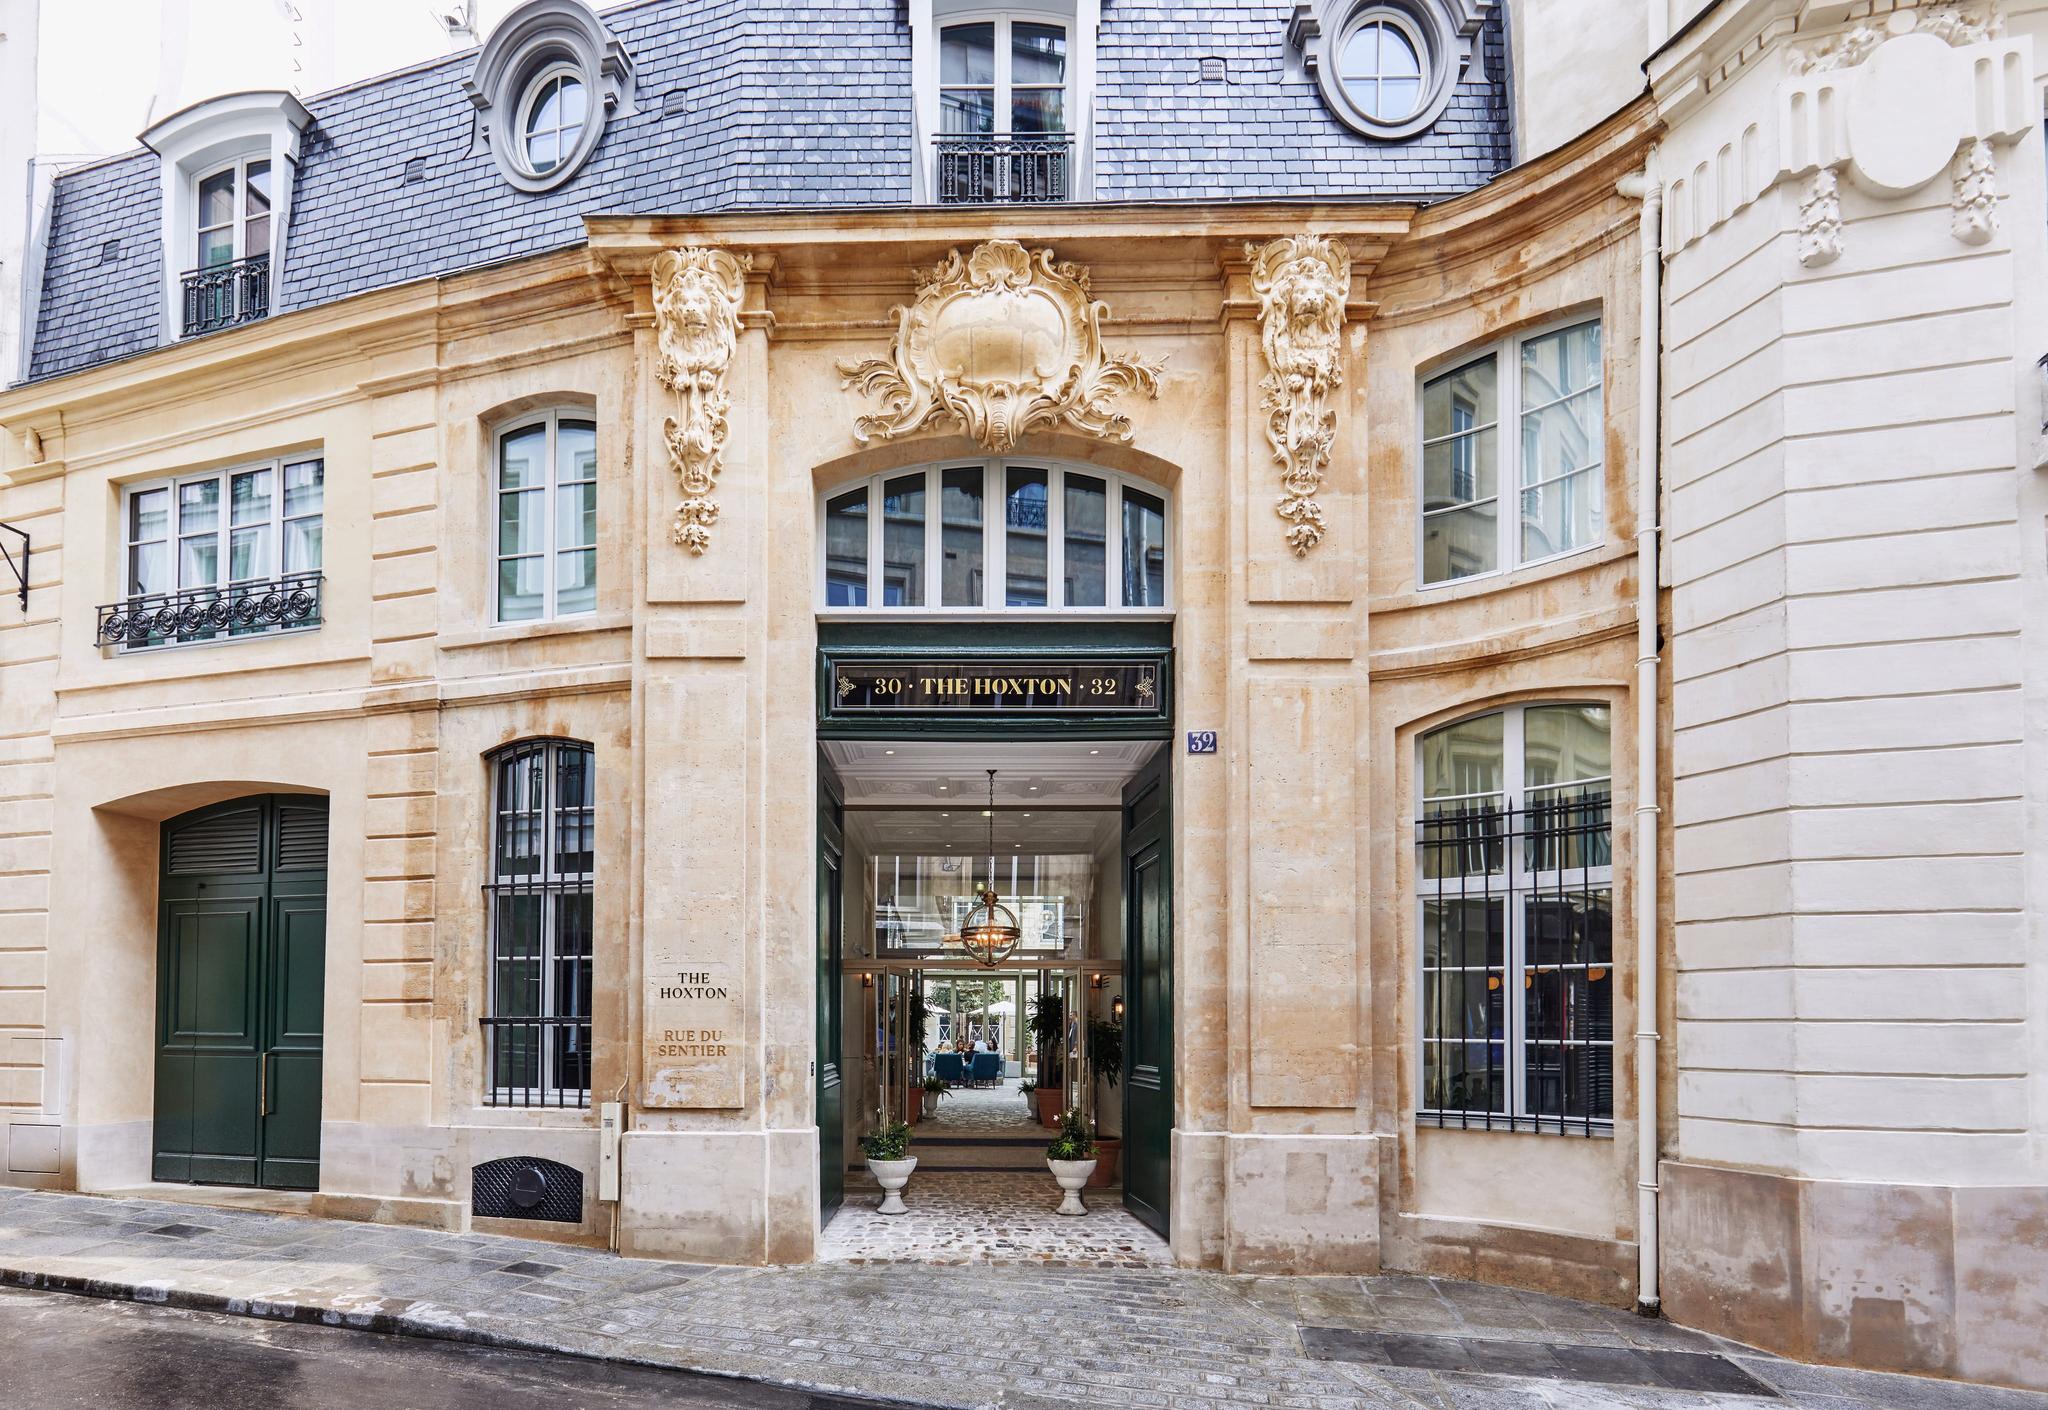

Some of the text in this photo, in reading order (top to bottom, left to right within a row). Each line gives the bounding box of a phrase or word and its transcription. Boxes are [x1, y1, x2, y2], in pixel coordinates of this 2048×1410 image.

[875, 678, 1116, 695] 30 THE HOXTON 32
[1191, 732, 1214, 752] 32
[678, 972, 710, 984] THE
[660, 987, 727, 999] HOXTON
[664, 1030, 722, 1042] RUE DU
[658, 1044, 727, 1057] SENTIER
